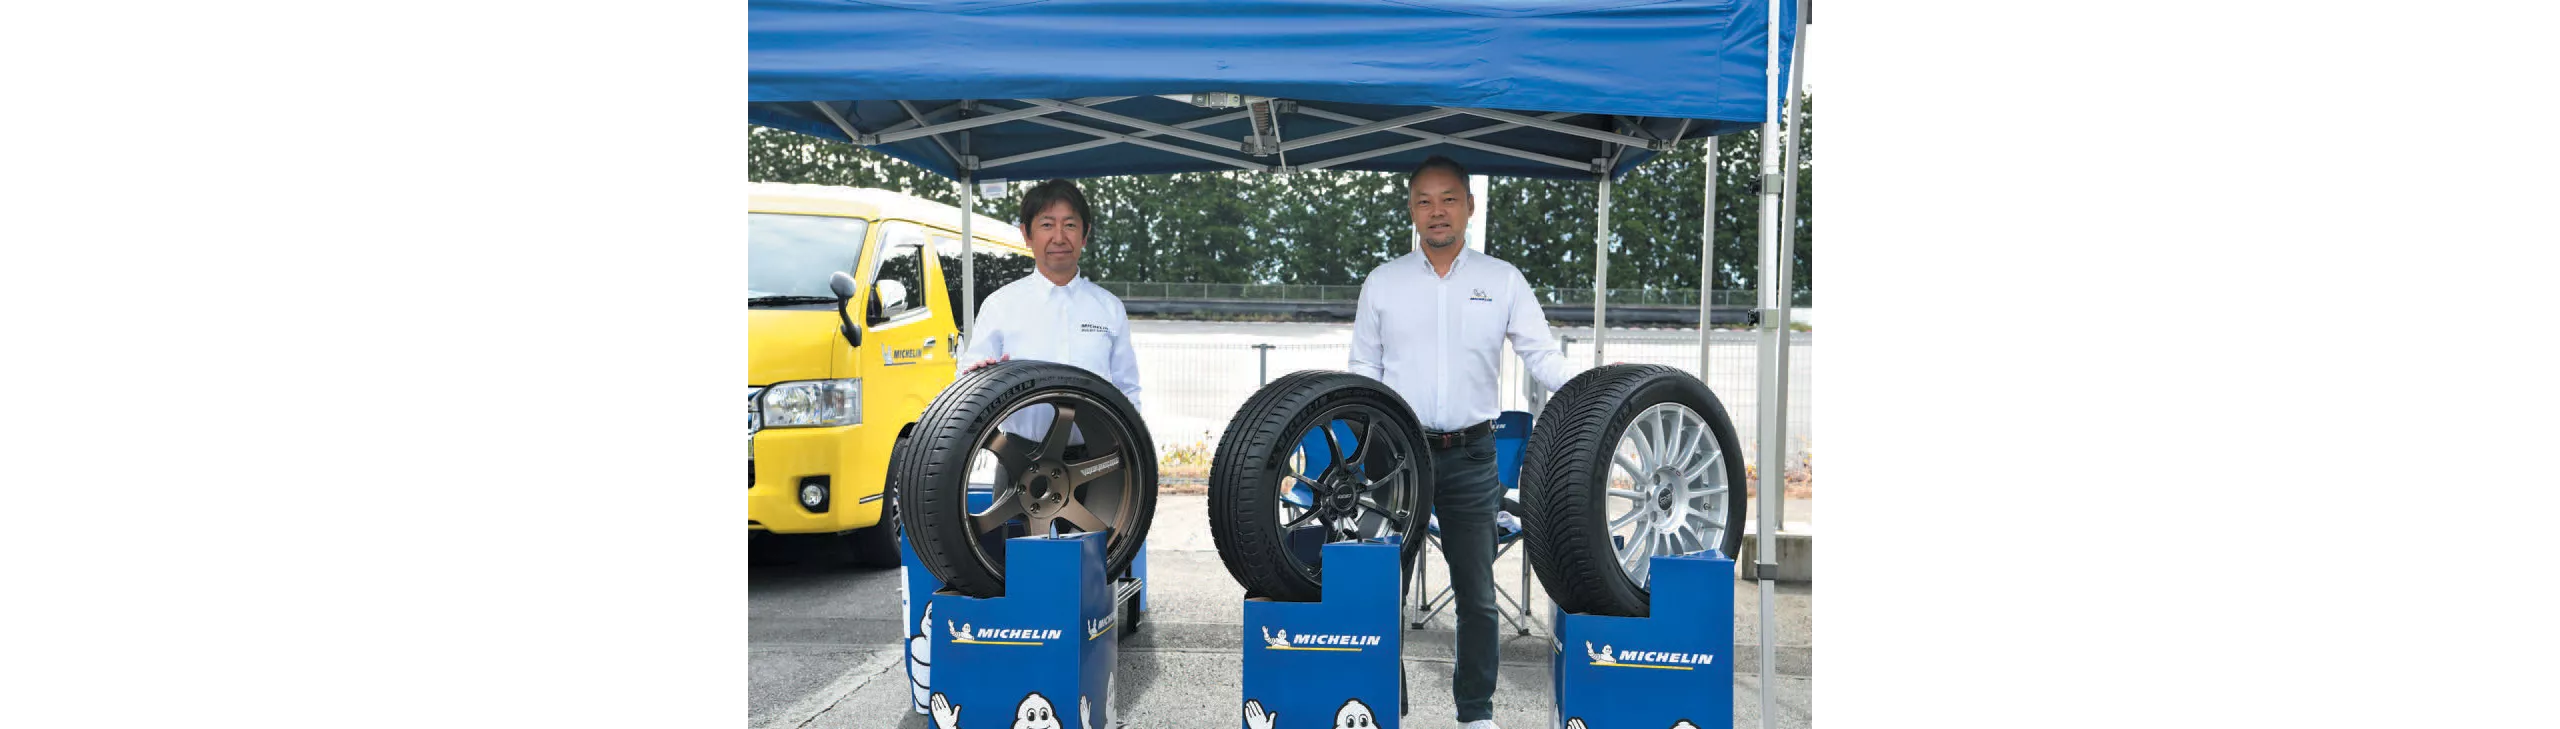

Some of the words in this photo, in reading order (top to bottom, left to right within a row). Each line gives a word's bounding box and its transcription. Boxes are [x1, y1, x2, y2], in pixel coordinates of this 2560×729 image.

[894, 349, 922, 358] MICHELIN
[980, 380, 1031, 420] MICHELIN
[977, 628, 1062, 640] MICHELIN
[1293, 634, 1381, 646] MICHELIN
[1619, 650, 1714, 665] MICHELIN
